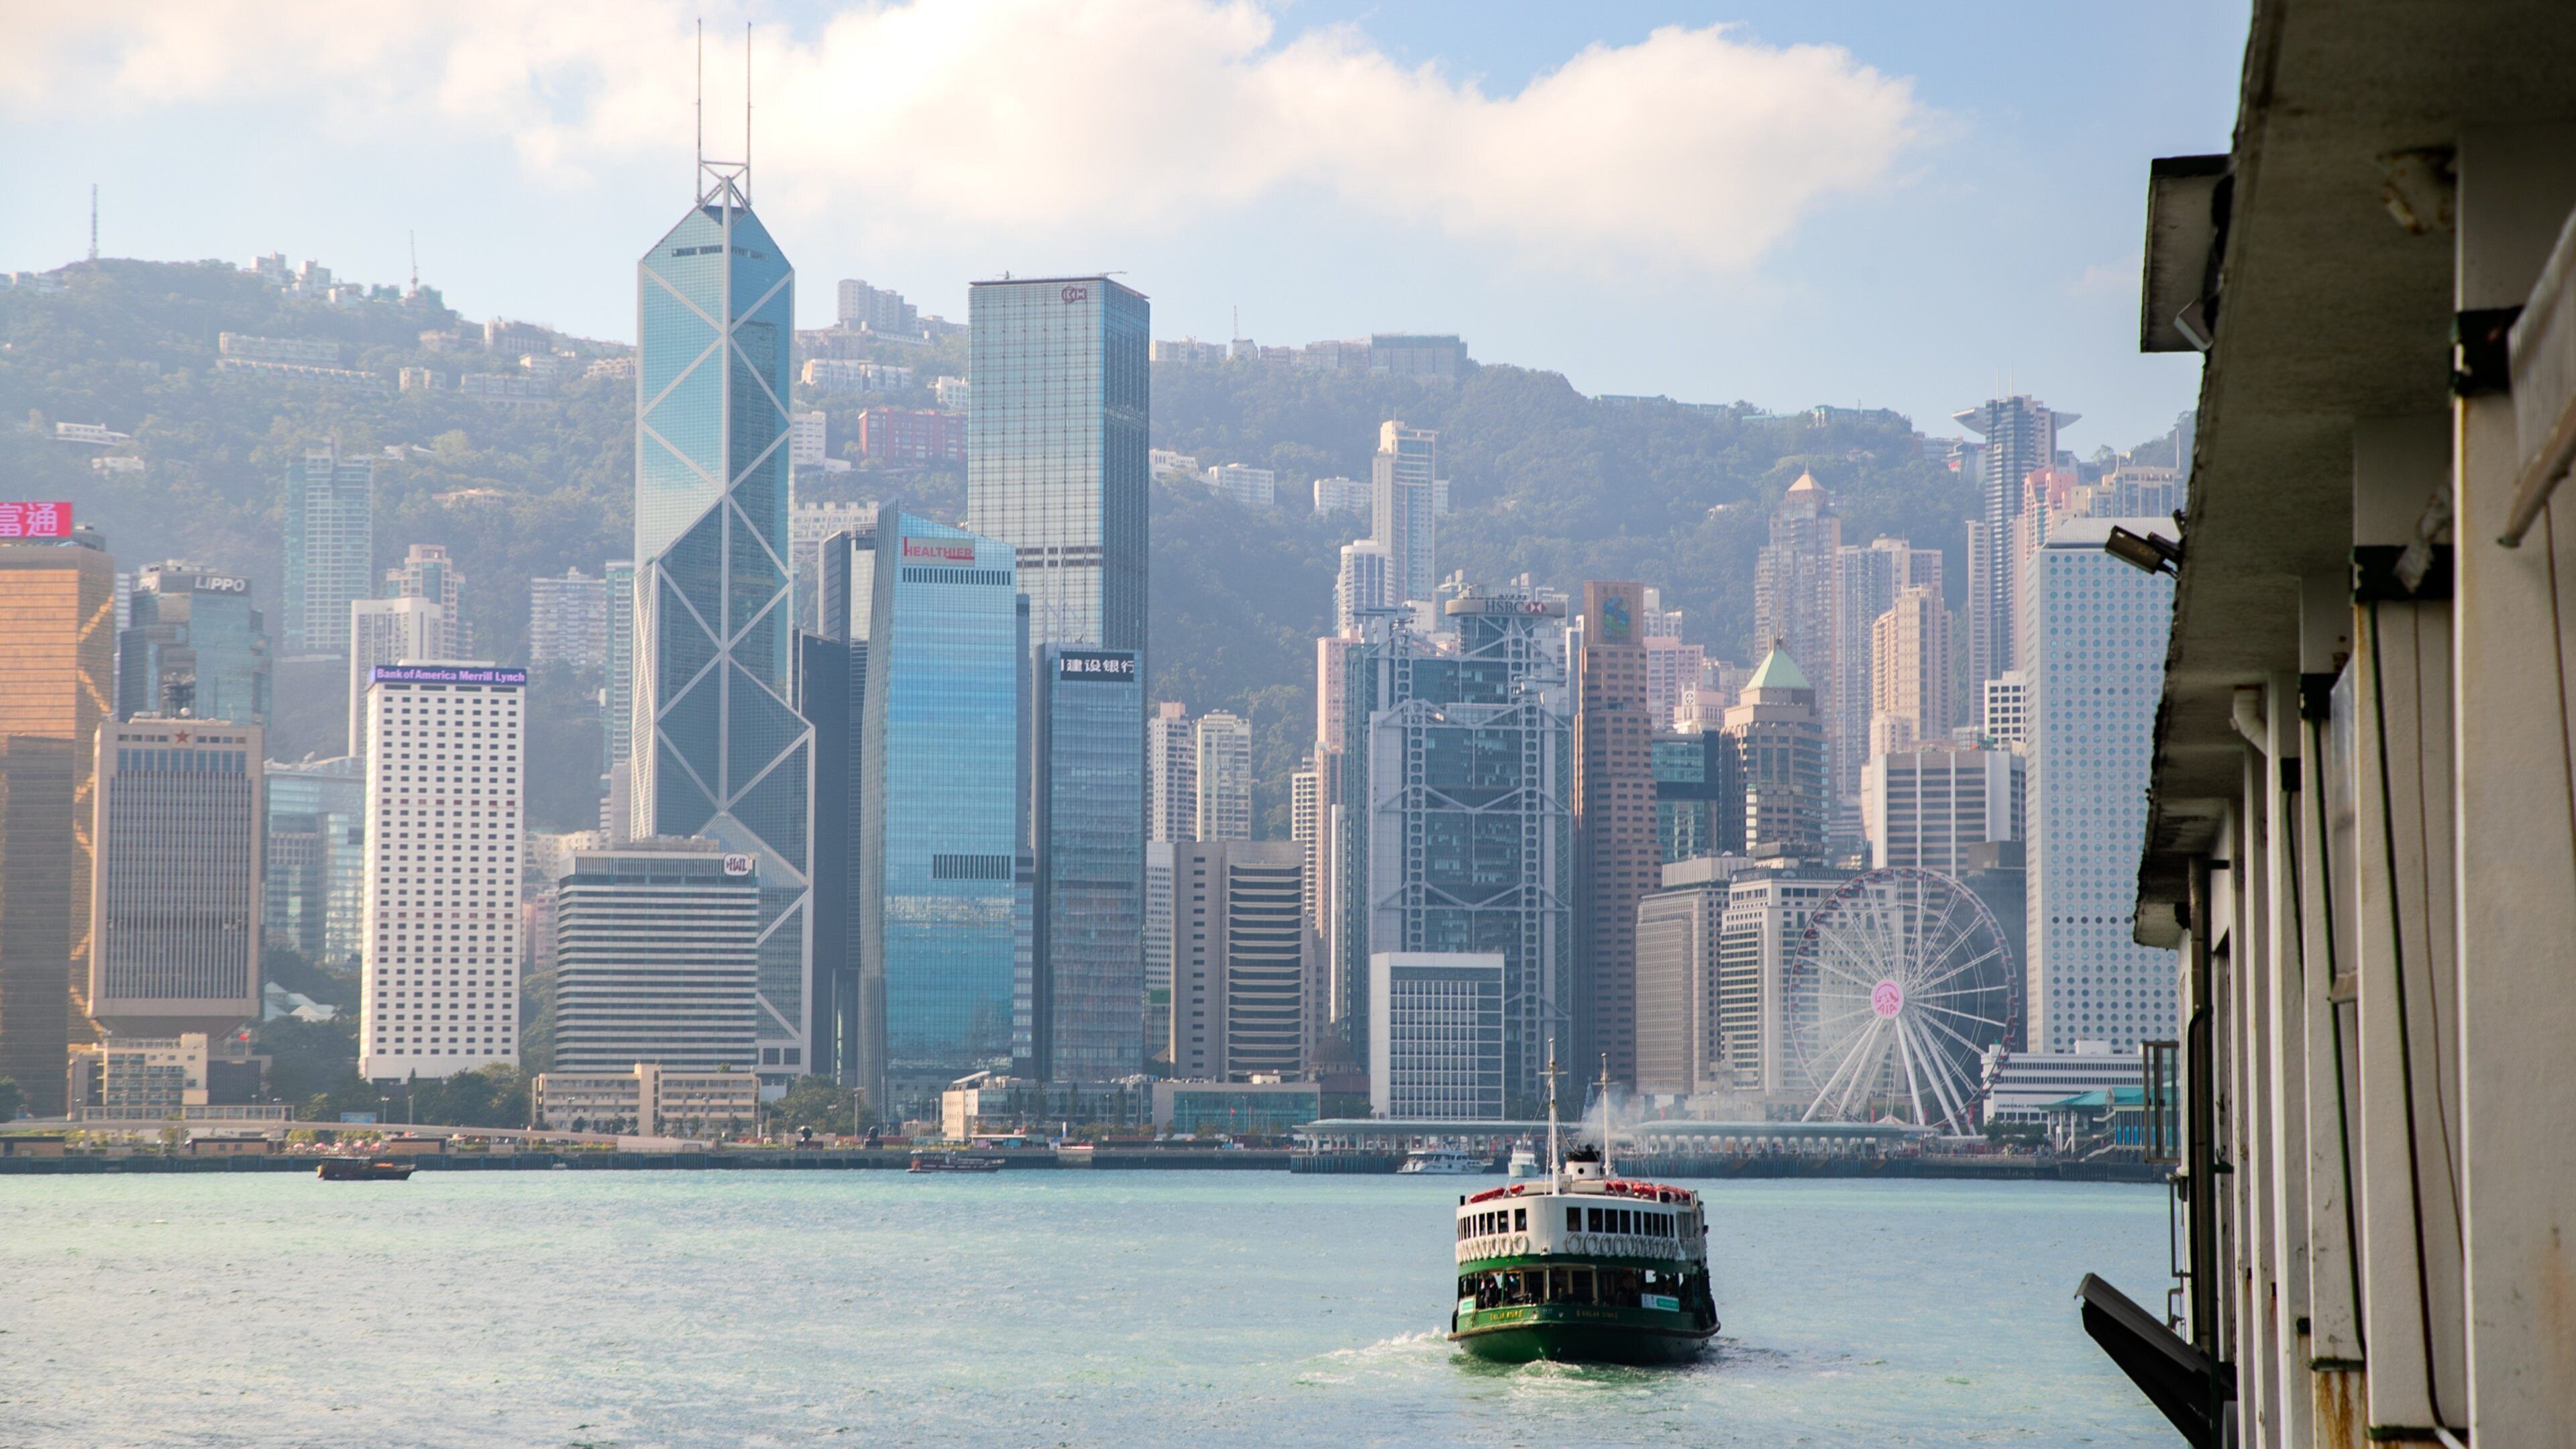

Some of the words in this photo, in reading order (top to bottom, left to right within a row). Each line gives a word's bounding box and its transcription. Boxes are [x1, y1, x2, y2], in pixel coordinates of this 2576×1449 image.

[903, 537, 975, 559] HEALTHIER
[195, 576, 246, 592] LIPPO
[1485, 600, 1524, 612] HSBC
[377, 669, 402, 679] Bank
[403, 669, 414, 679] of
[415, 669, 457, 680] America
[458, 671, 492, 681] Merrill
[495, 672, 525, 684] Lynch
[1799, 871, 1846, 879] MANDARIN
[1878, 1004, 1897, 1014] AIA
